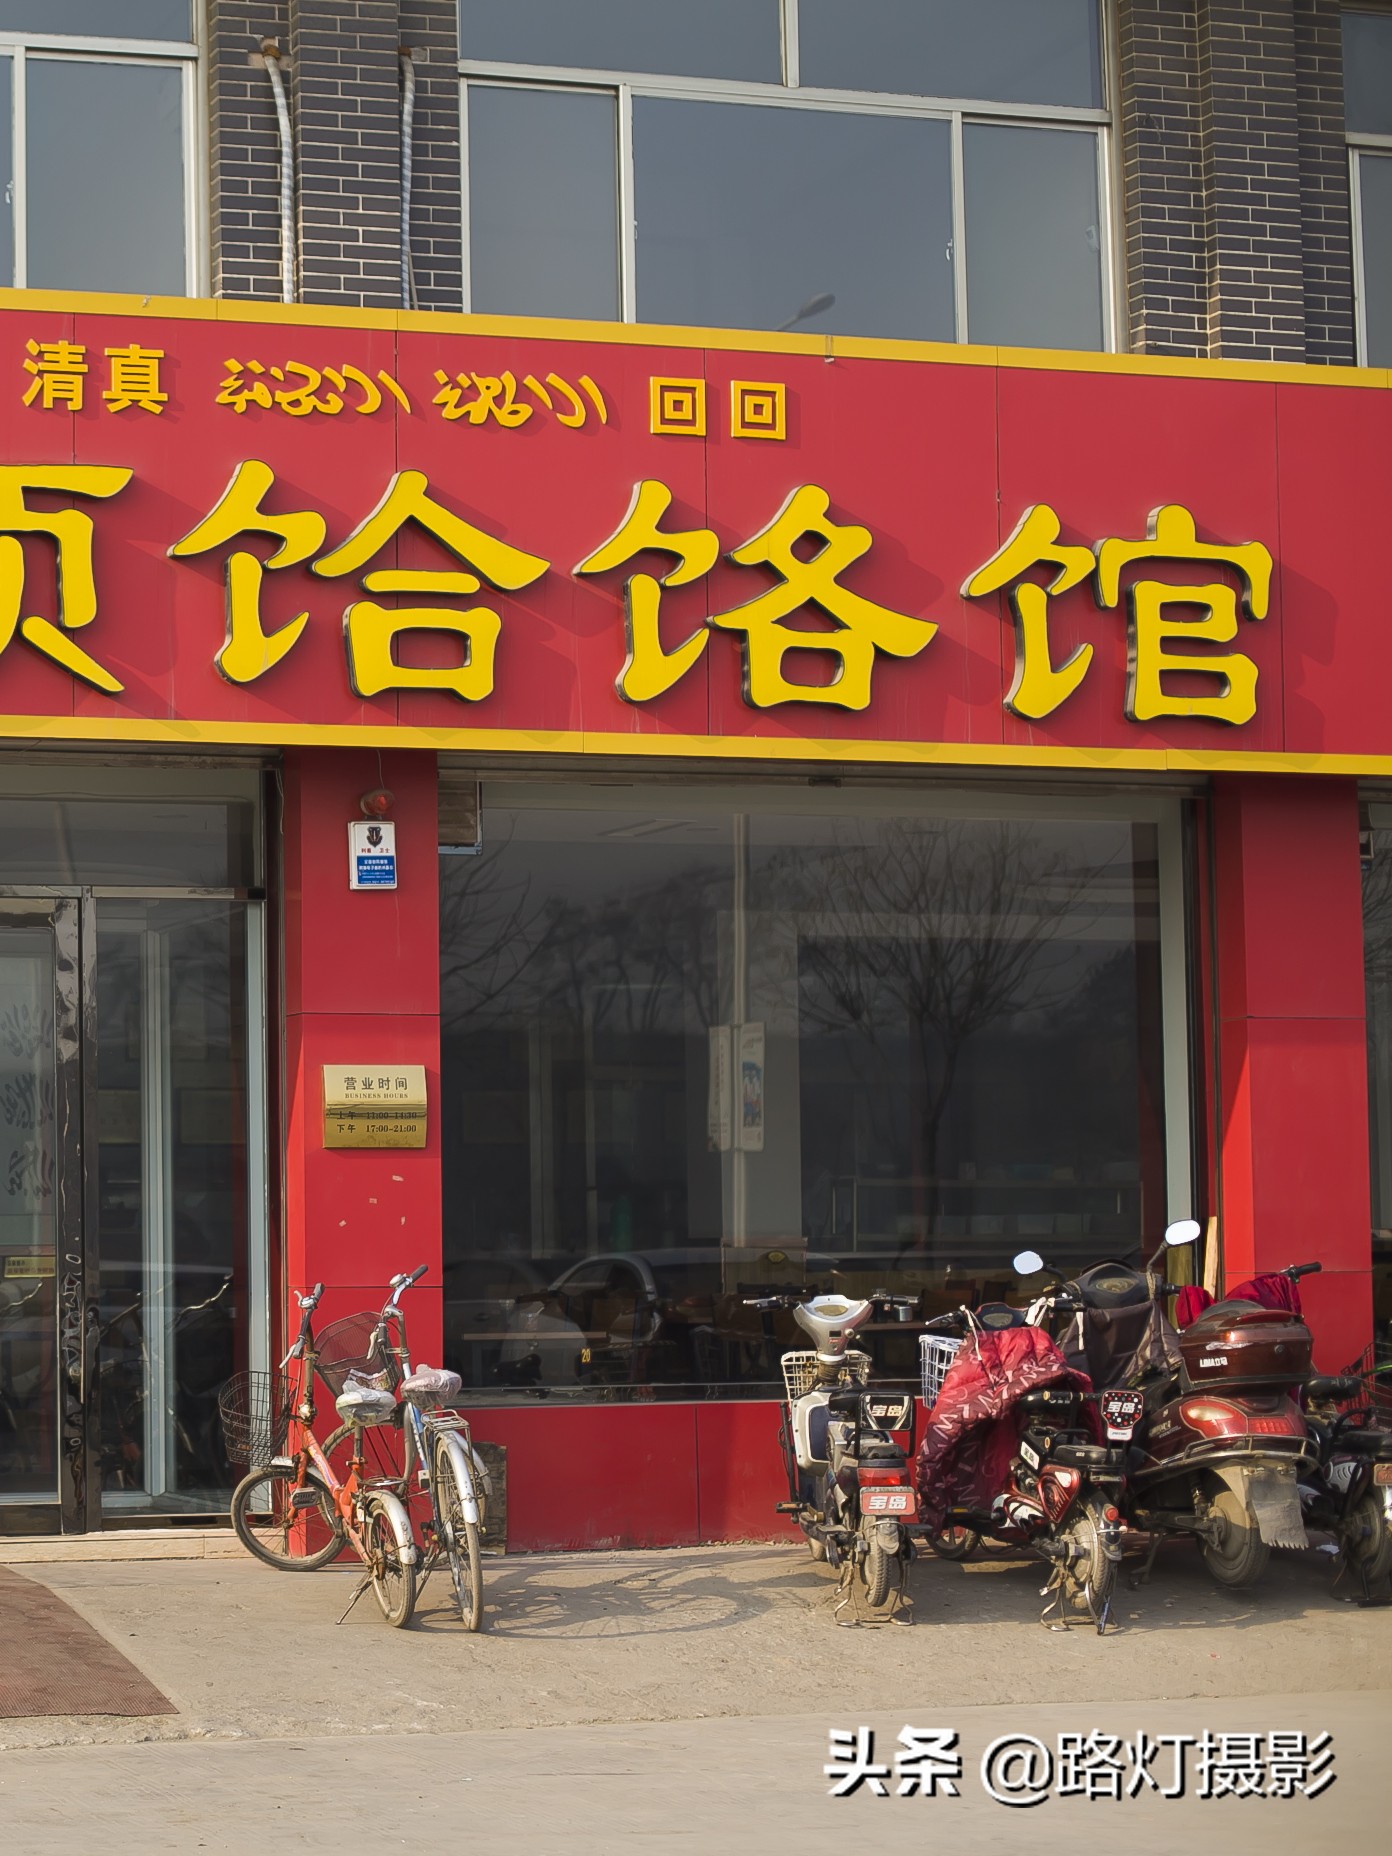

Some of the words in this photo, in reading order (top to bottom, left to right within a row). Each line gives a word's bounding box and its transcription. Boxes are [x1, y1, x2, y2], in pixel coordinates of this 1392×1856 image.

[21, 338, 170, 415] 清真
[344, 1077, 408, 1091] 营业时间
[337, 1111, 356, 1120] 上午
[337, 1124, 356, 1133] 下午
[366, 1125, 417, 1133] 17:00-21:00
[872, 1404, 903, 1417] 宝岛
[1107, 1401, 1135, 1414] 宝岛
[868, 1495, 907, 1510] 宝岛
